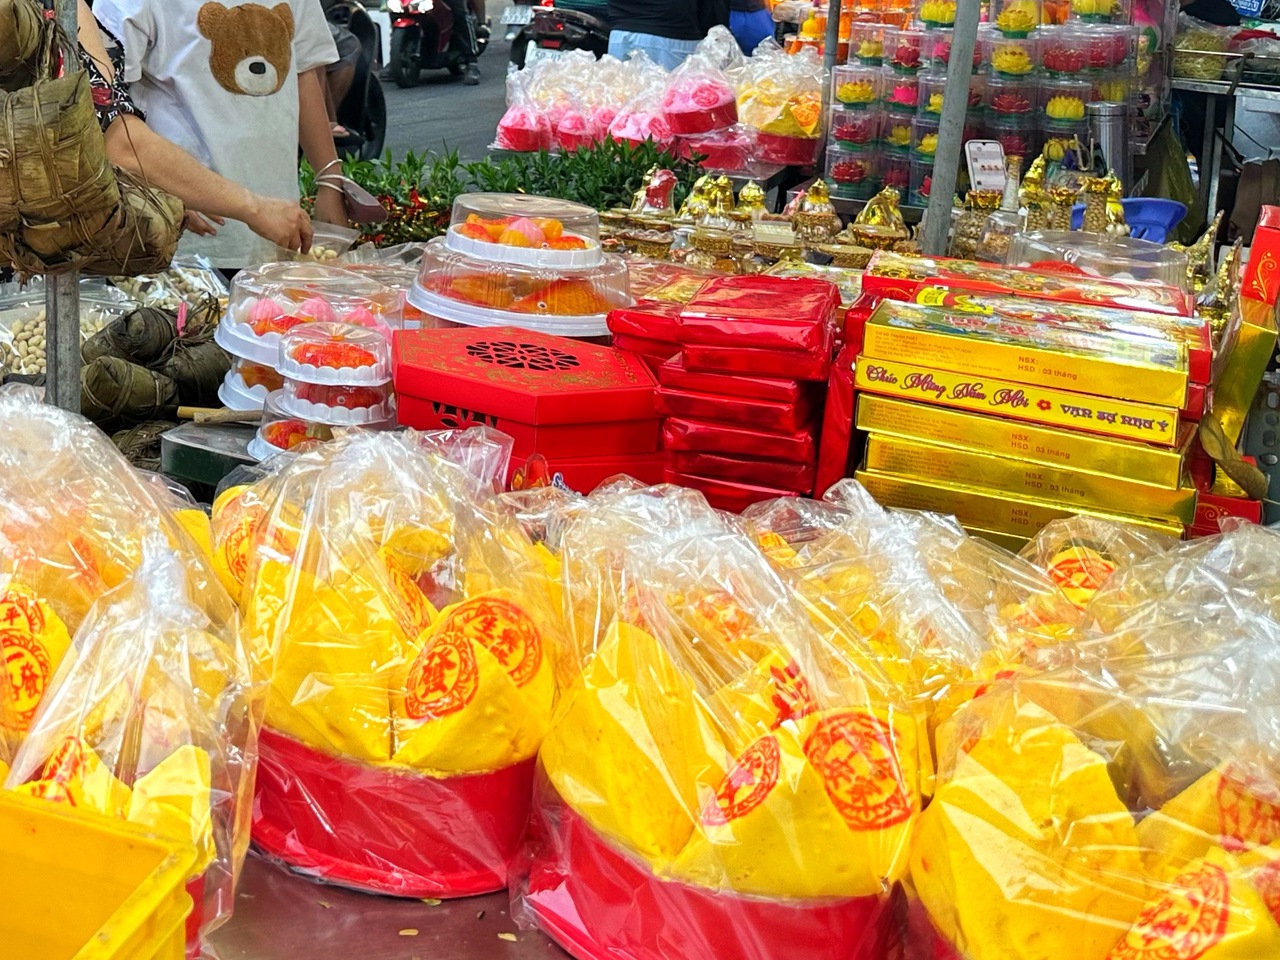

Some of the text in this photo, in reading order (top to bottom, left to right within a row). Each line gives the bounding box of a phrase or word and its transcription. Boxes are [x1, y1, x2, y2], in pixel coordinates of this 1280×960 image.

[1017, 364, 1036, 374] HSD
[1054, 369, 1078, 381] tháng
[1011, 441, 1029, 450] HSD
[1047, 447, 1070, 460] tháng
